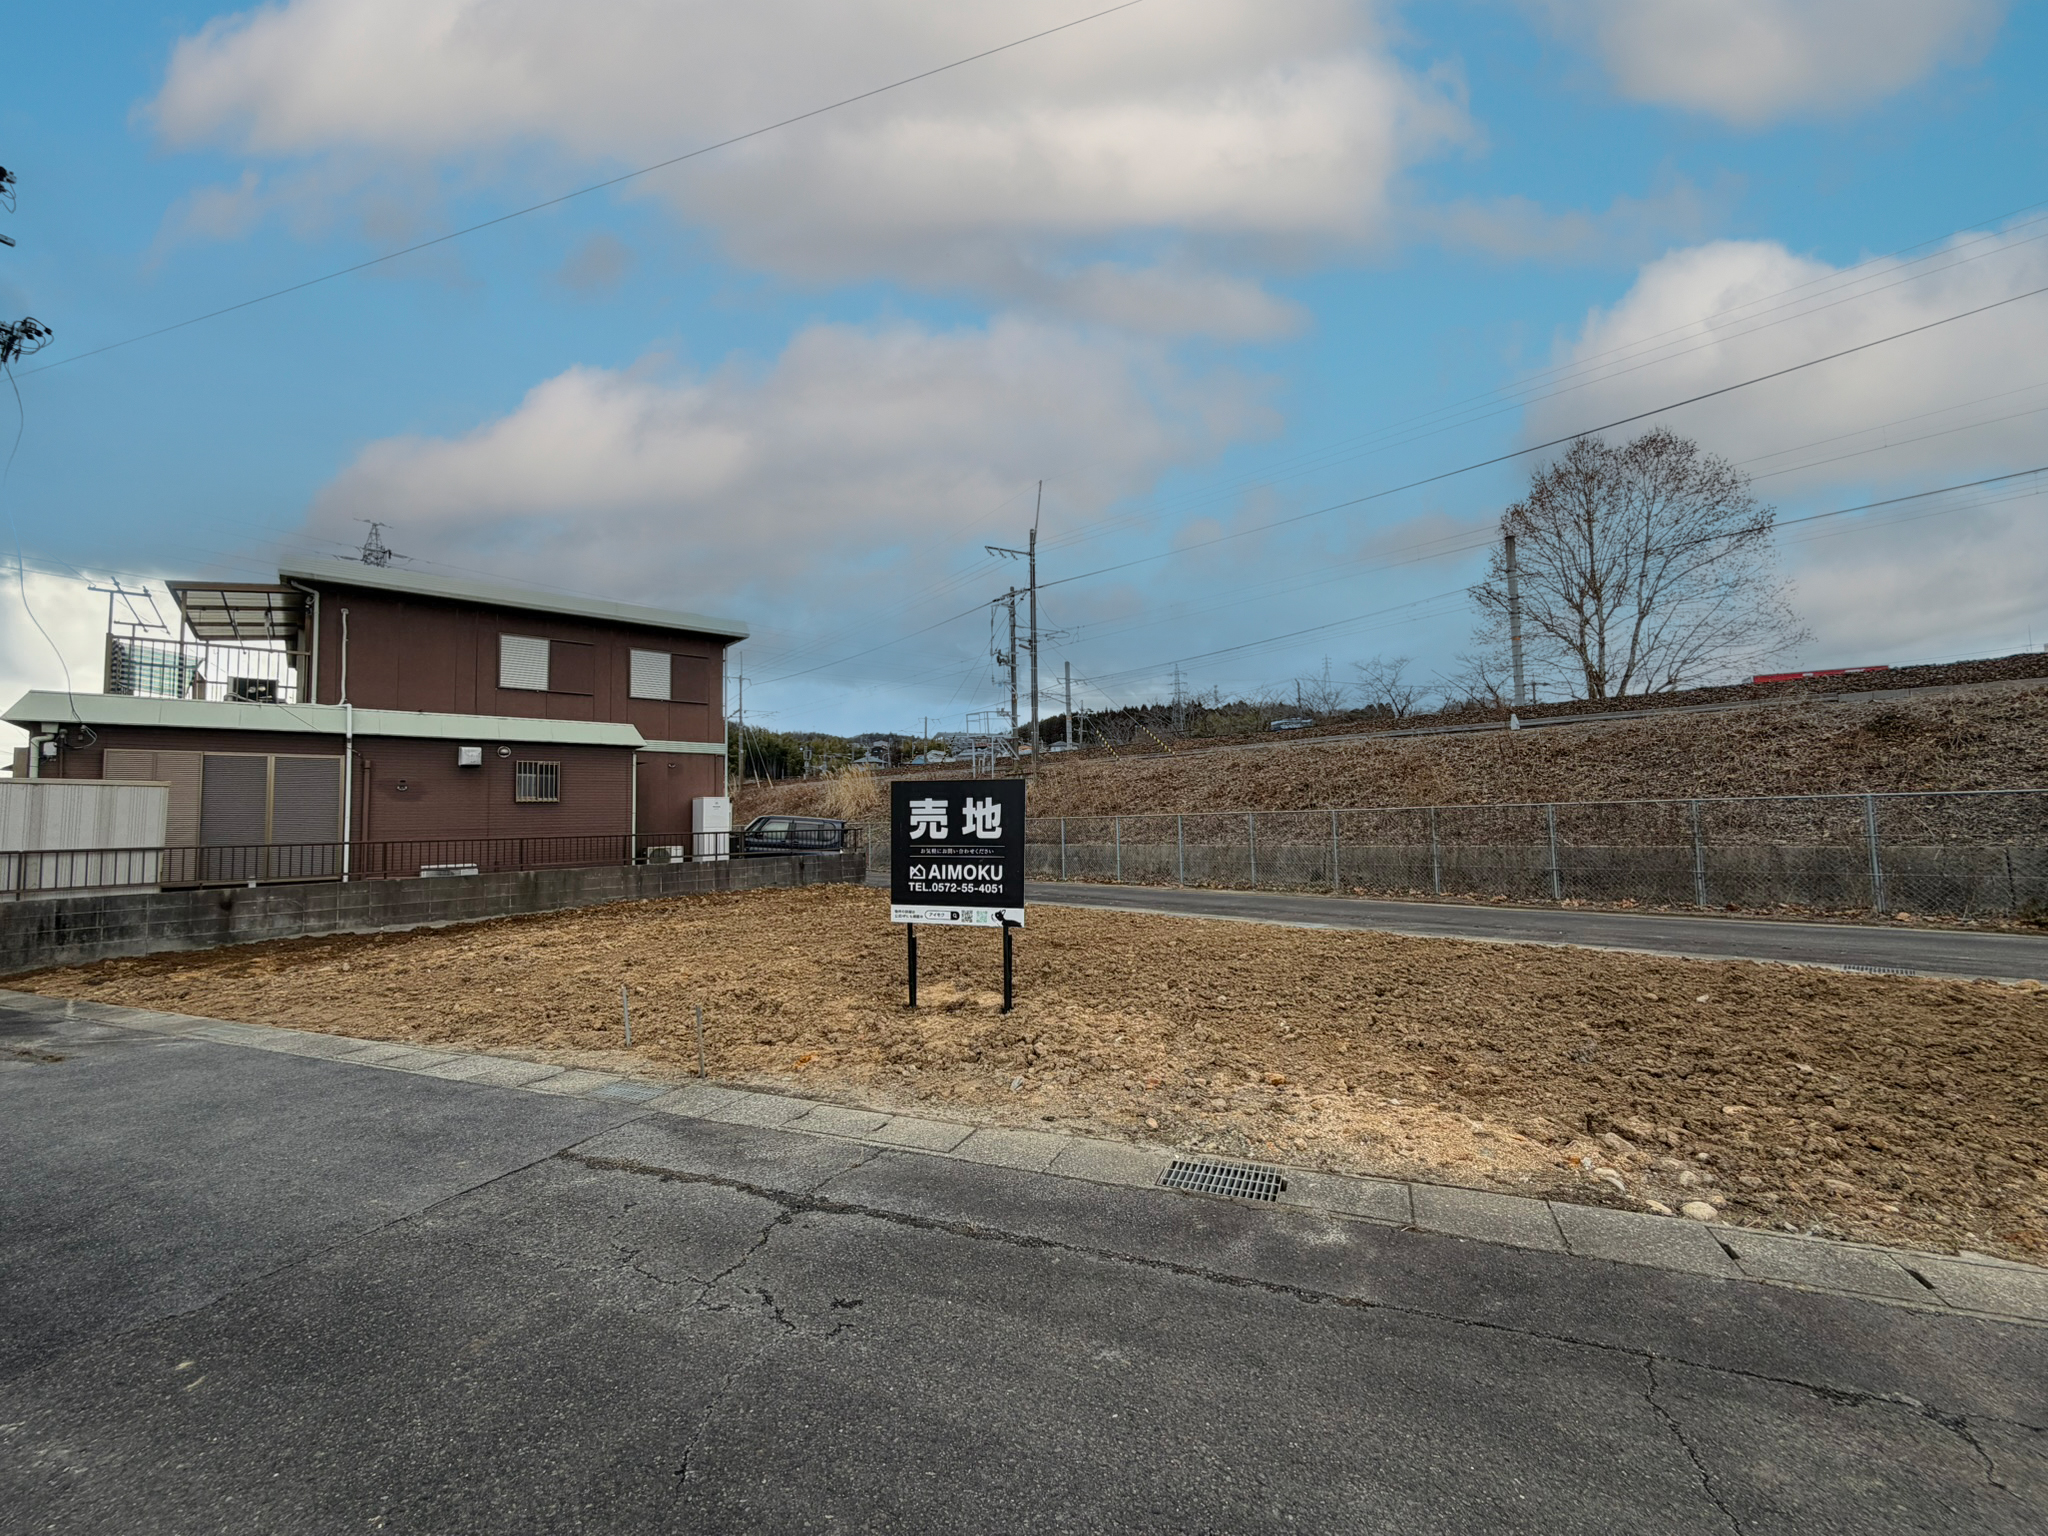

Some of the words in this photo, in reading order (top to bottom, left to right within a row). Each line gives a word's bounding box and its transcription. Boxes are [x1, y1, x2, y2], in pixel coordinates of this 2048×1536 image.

[909, 797, 1003, 840] 売地
[928, 864, 1003, 881] AIMOKU
[908, 882, 1003, 894] TEL.0572-55-4051
